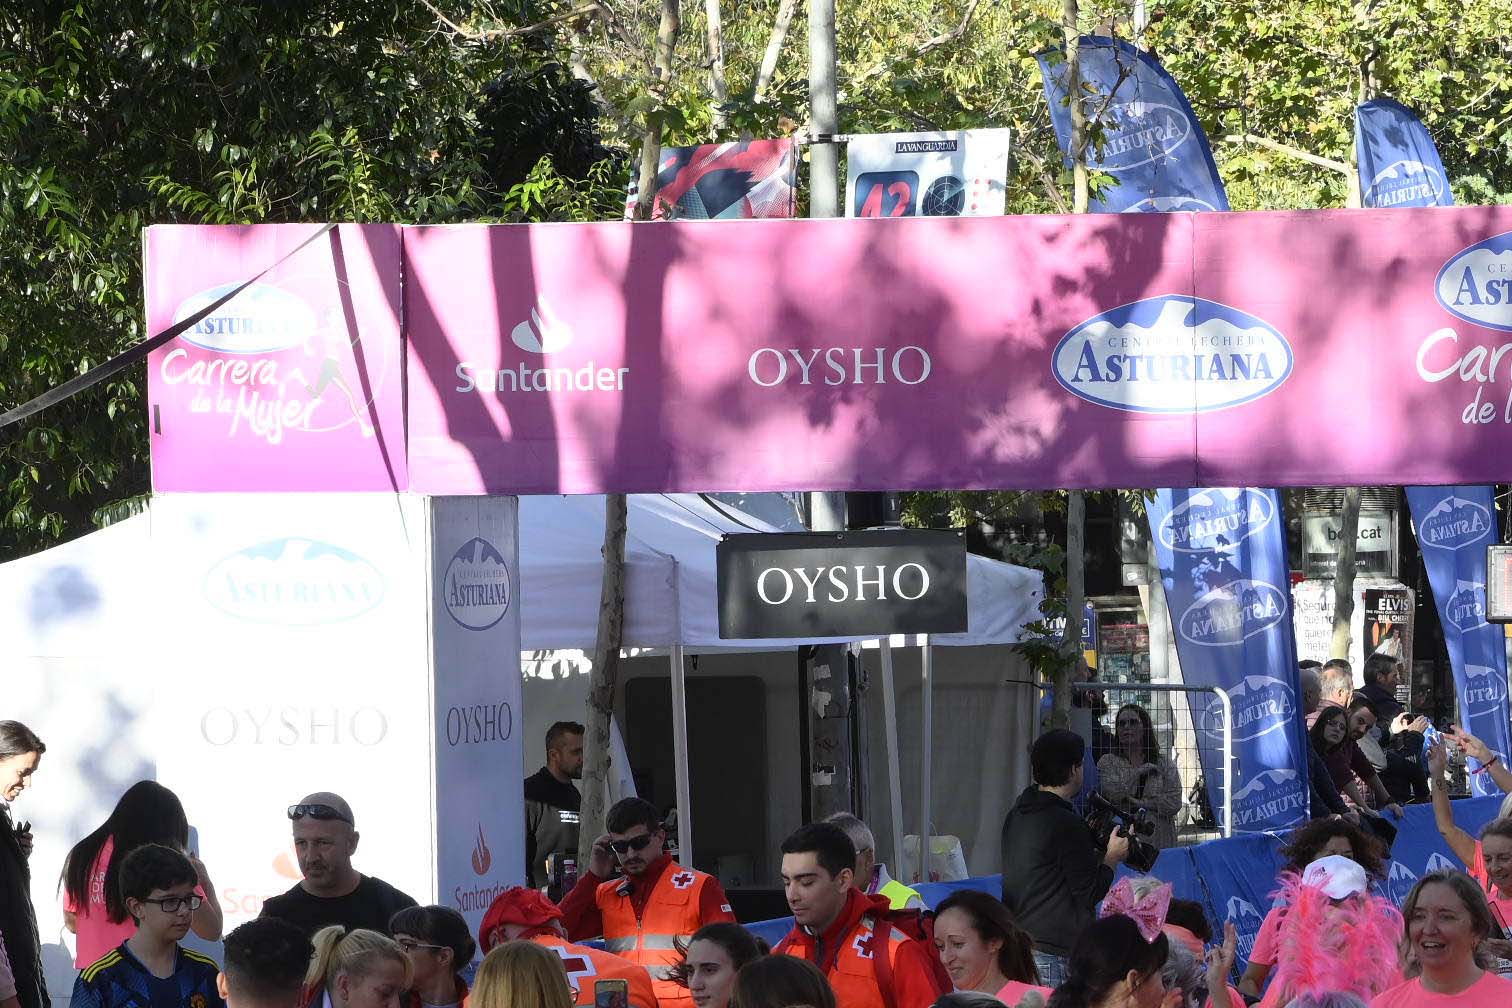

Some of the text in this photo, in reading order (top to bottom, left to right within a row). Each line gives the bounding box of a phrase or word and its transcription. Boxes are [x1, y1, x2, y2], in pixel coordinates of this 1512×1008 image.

[160, 347, 278, 386] Carrera
[454, 360, 630, 393] Santander
[748, 345, 932, 388] OYSHO
[1071, 338, 1275, 383] ASTURIANA
[1462, 386, 1497, 424] de
[450, 579, 507, 608] ASTURIANA
[757, 563, 931, 605] OYSHO
[1378, 598, 1409, 611] ELVIS
[201, 704, 389, 749] OYSHO
[446, 701, 513, 748] OYSHO
